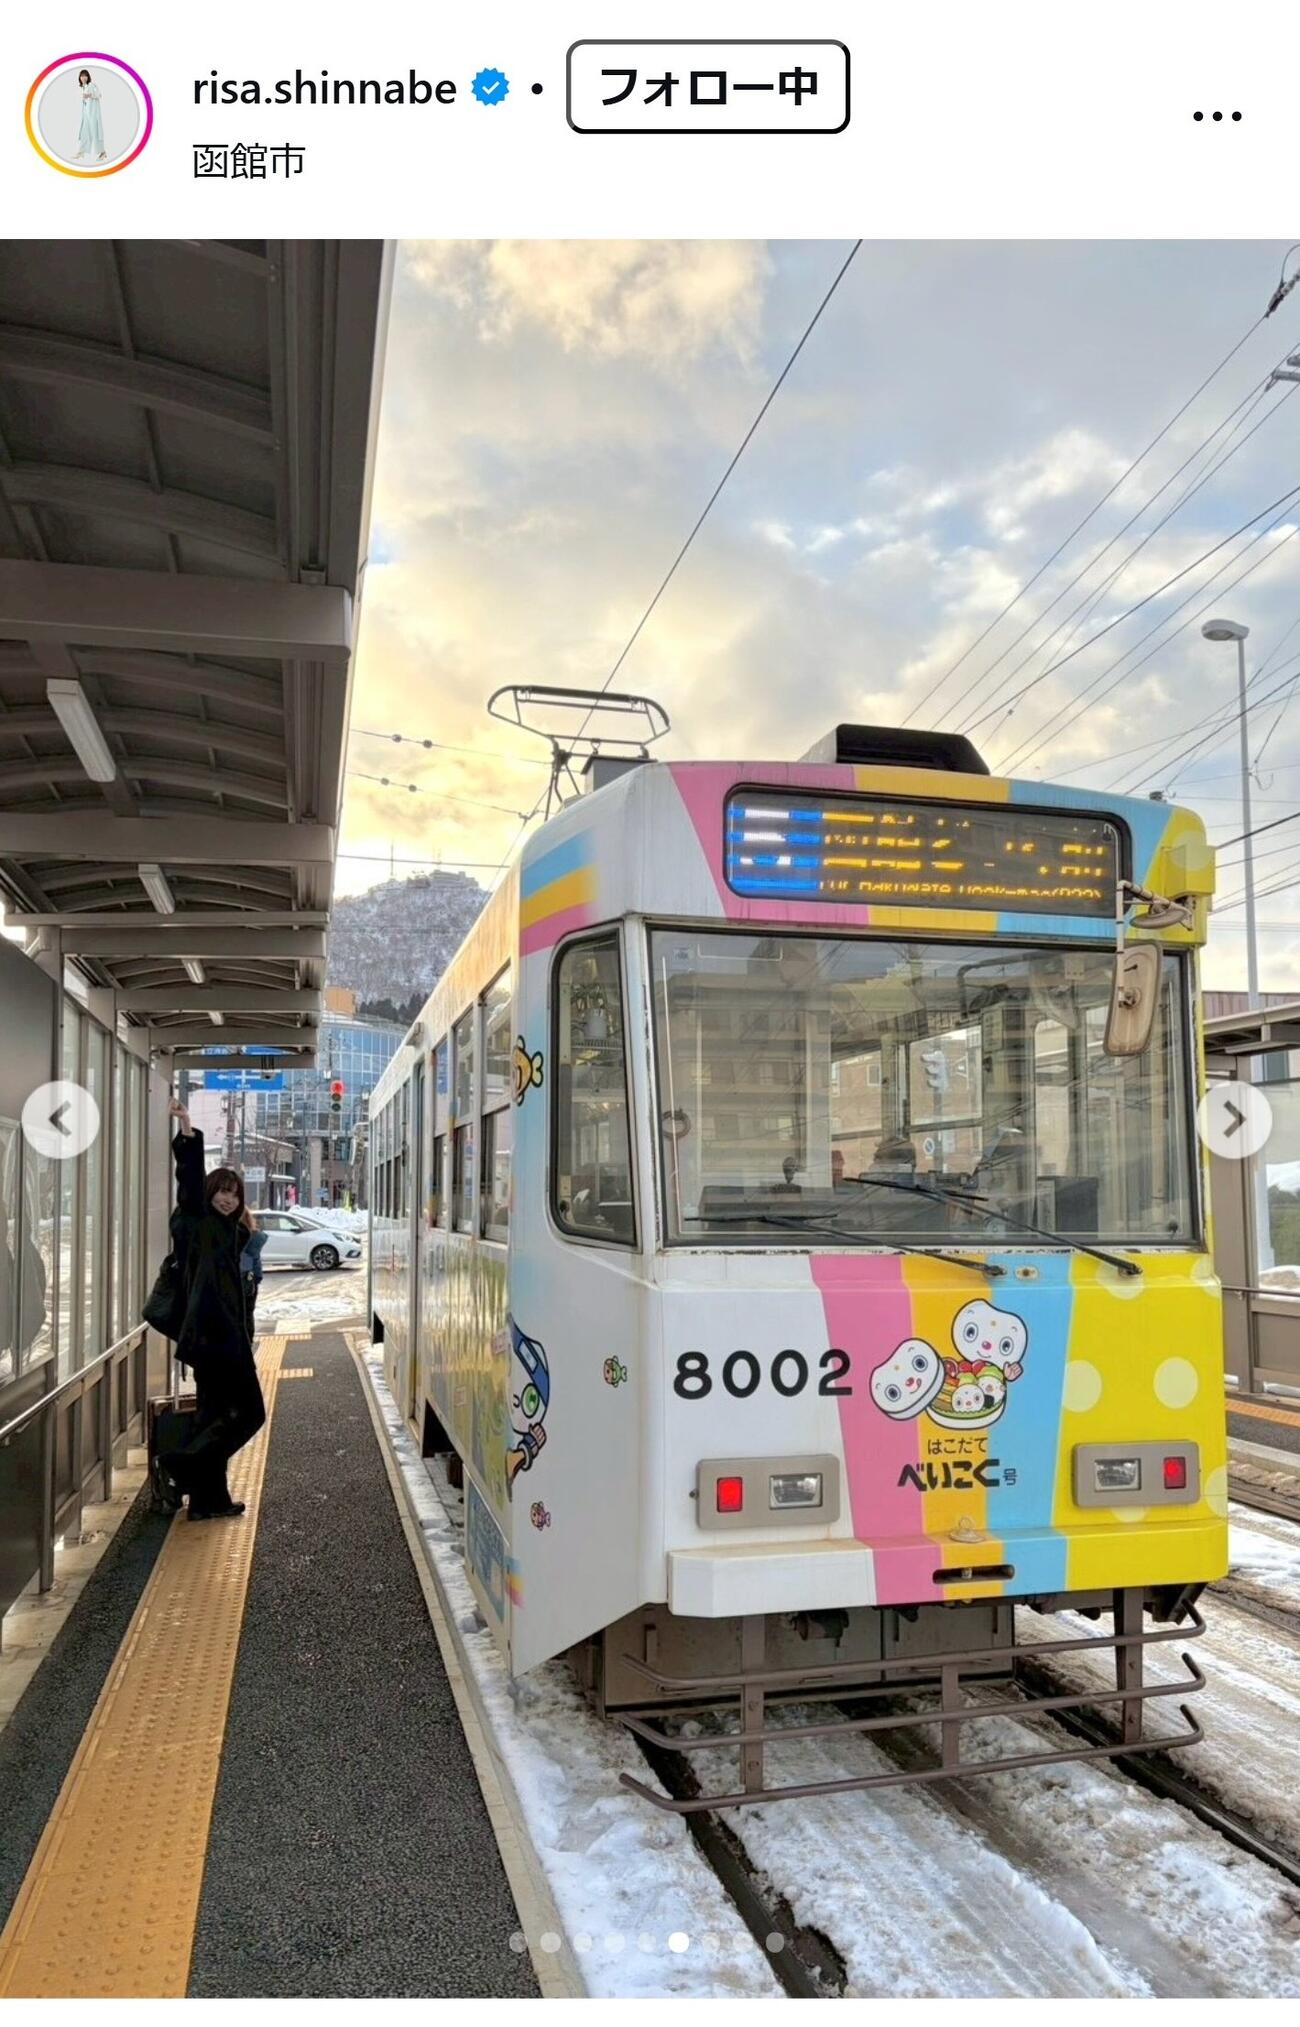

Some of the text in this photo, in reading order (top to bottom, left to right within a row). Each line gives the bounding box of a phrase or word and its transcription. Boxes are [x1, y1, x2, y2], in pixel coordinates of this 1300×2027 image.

[673, 1348, 853, 1400] 8002
[927, 1437, 988, 1455] はこだて
[897, 1458, 1018, 1492] べいこく号
